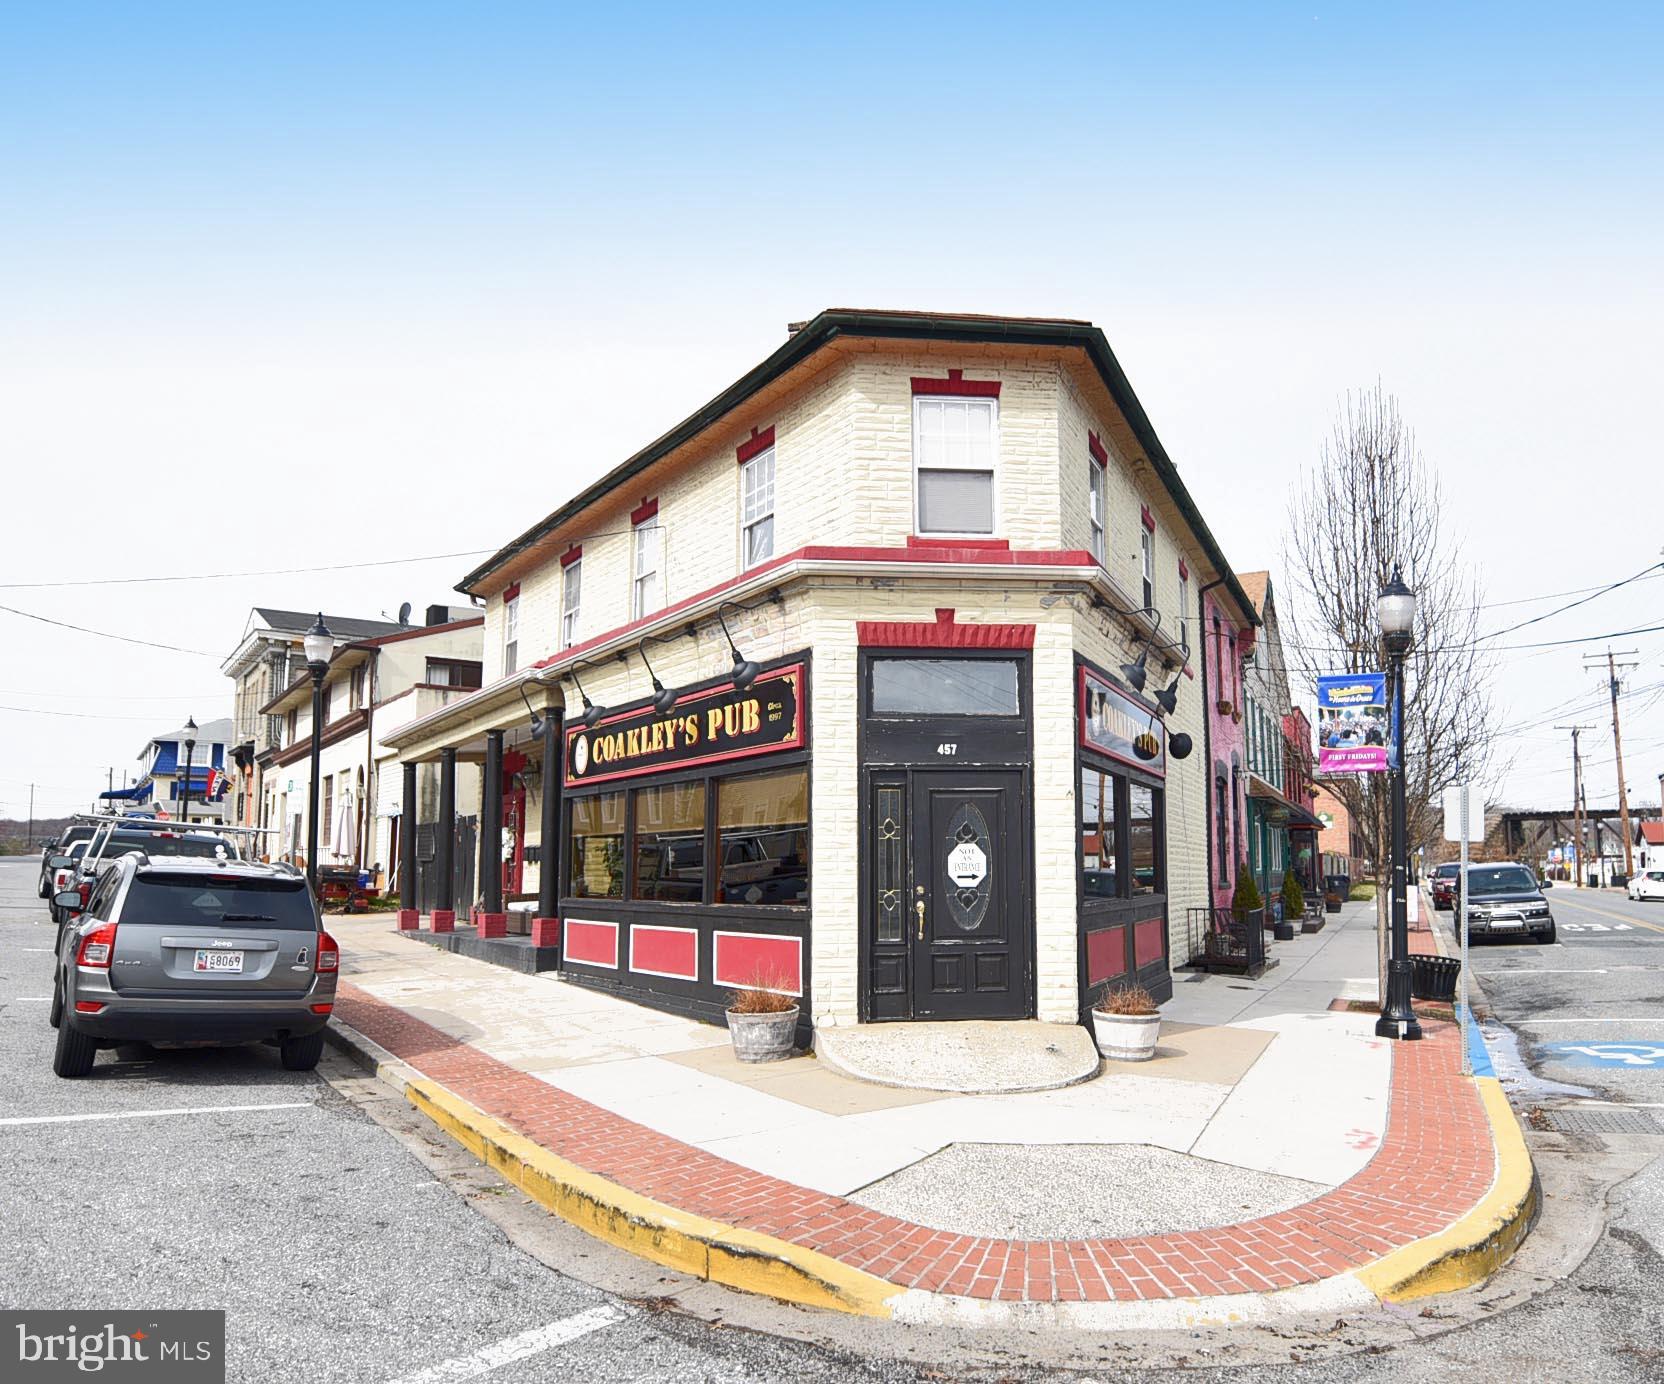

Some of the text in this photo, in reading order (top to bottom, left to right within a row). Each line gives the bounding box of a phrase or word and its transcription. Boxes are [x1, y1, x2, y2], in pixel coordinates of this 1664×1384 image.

[592, 699, 760, 764] COAKLEY'S PUB
[937, 743, 957, 755] 457
[954, 862, 981, 872] ENTRANCE
[211, 940, 233, 948] Jeep
